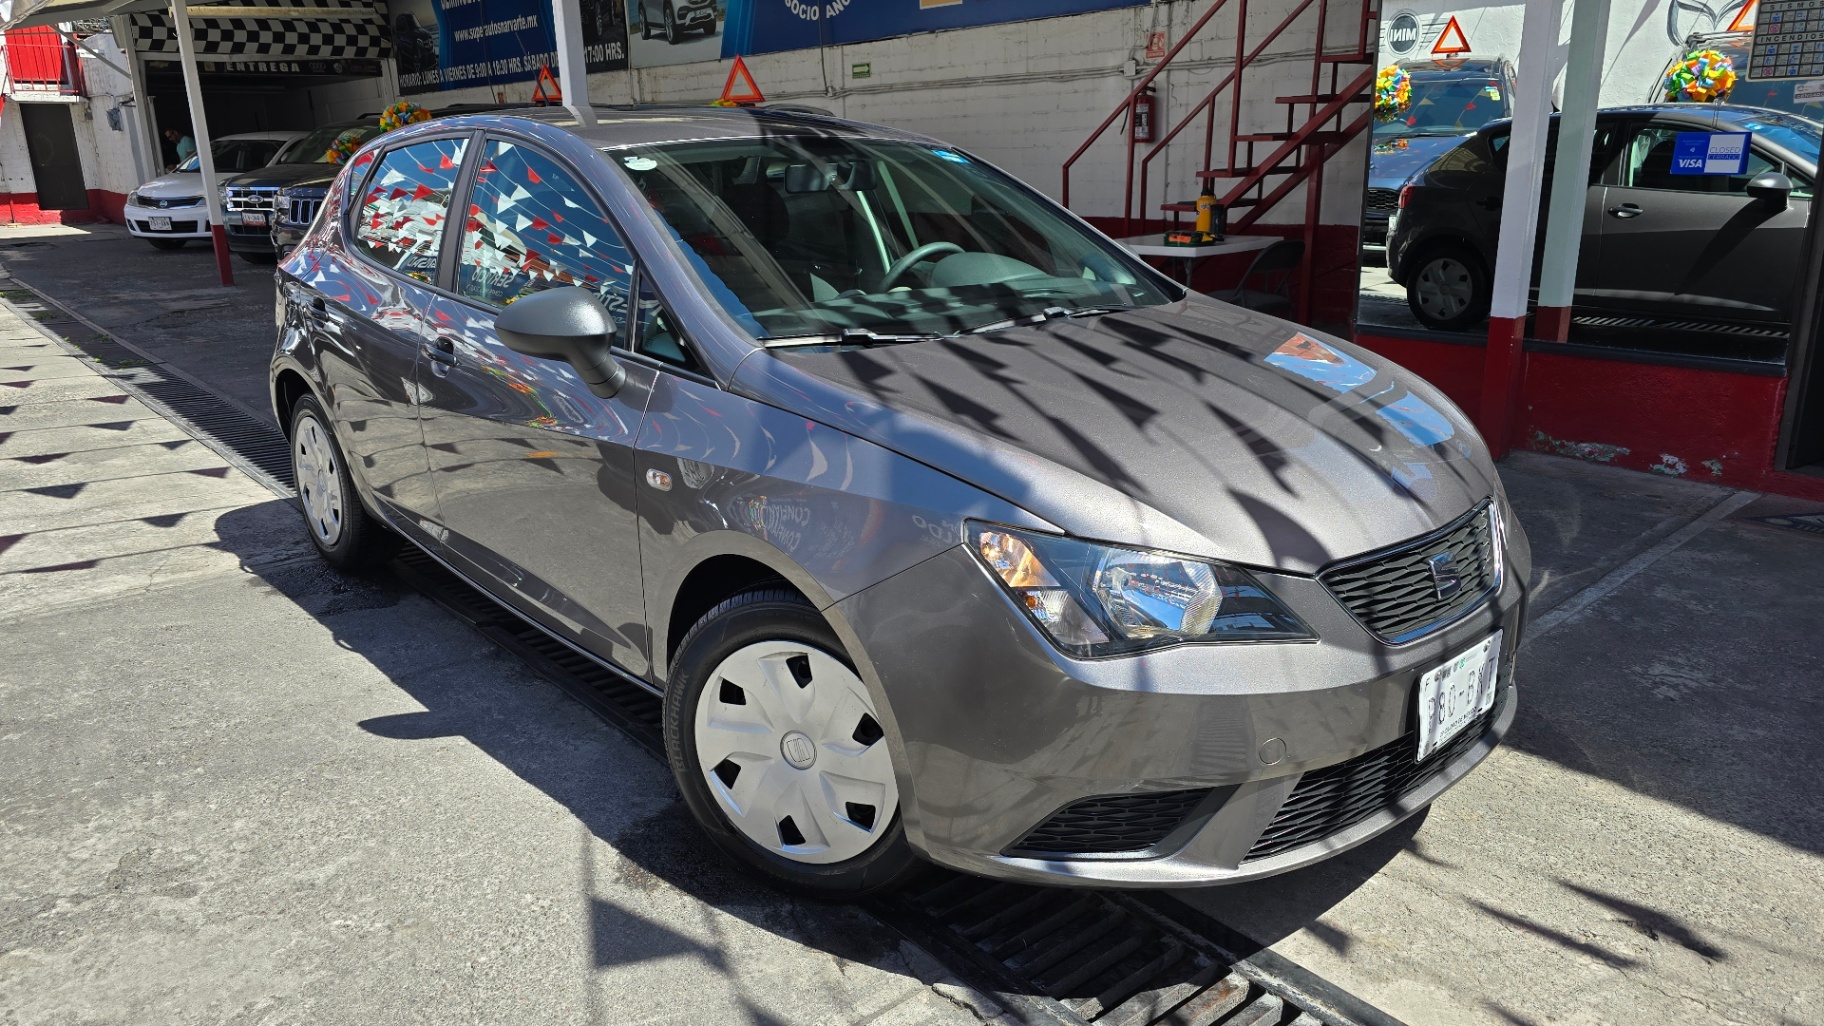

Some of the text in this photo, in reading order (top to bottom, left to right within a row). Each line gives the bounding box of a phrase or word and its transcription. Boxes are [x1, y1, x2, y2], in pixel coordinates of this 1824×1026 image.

[1770, 2, 1824, 11] SISMOS
[1760, 33, 1824, 43] INCENDIOS
[467, 63, 476, 79] DE
[605, 41, 625, 61] HRS.
[226, 61, 300, 73] ENTREGA
[1709, 146, 1741, 154] CLOSED
[1678, 159, 1703, 168] VISA
